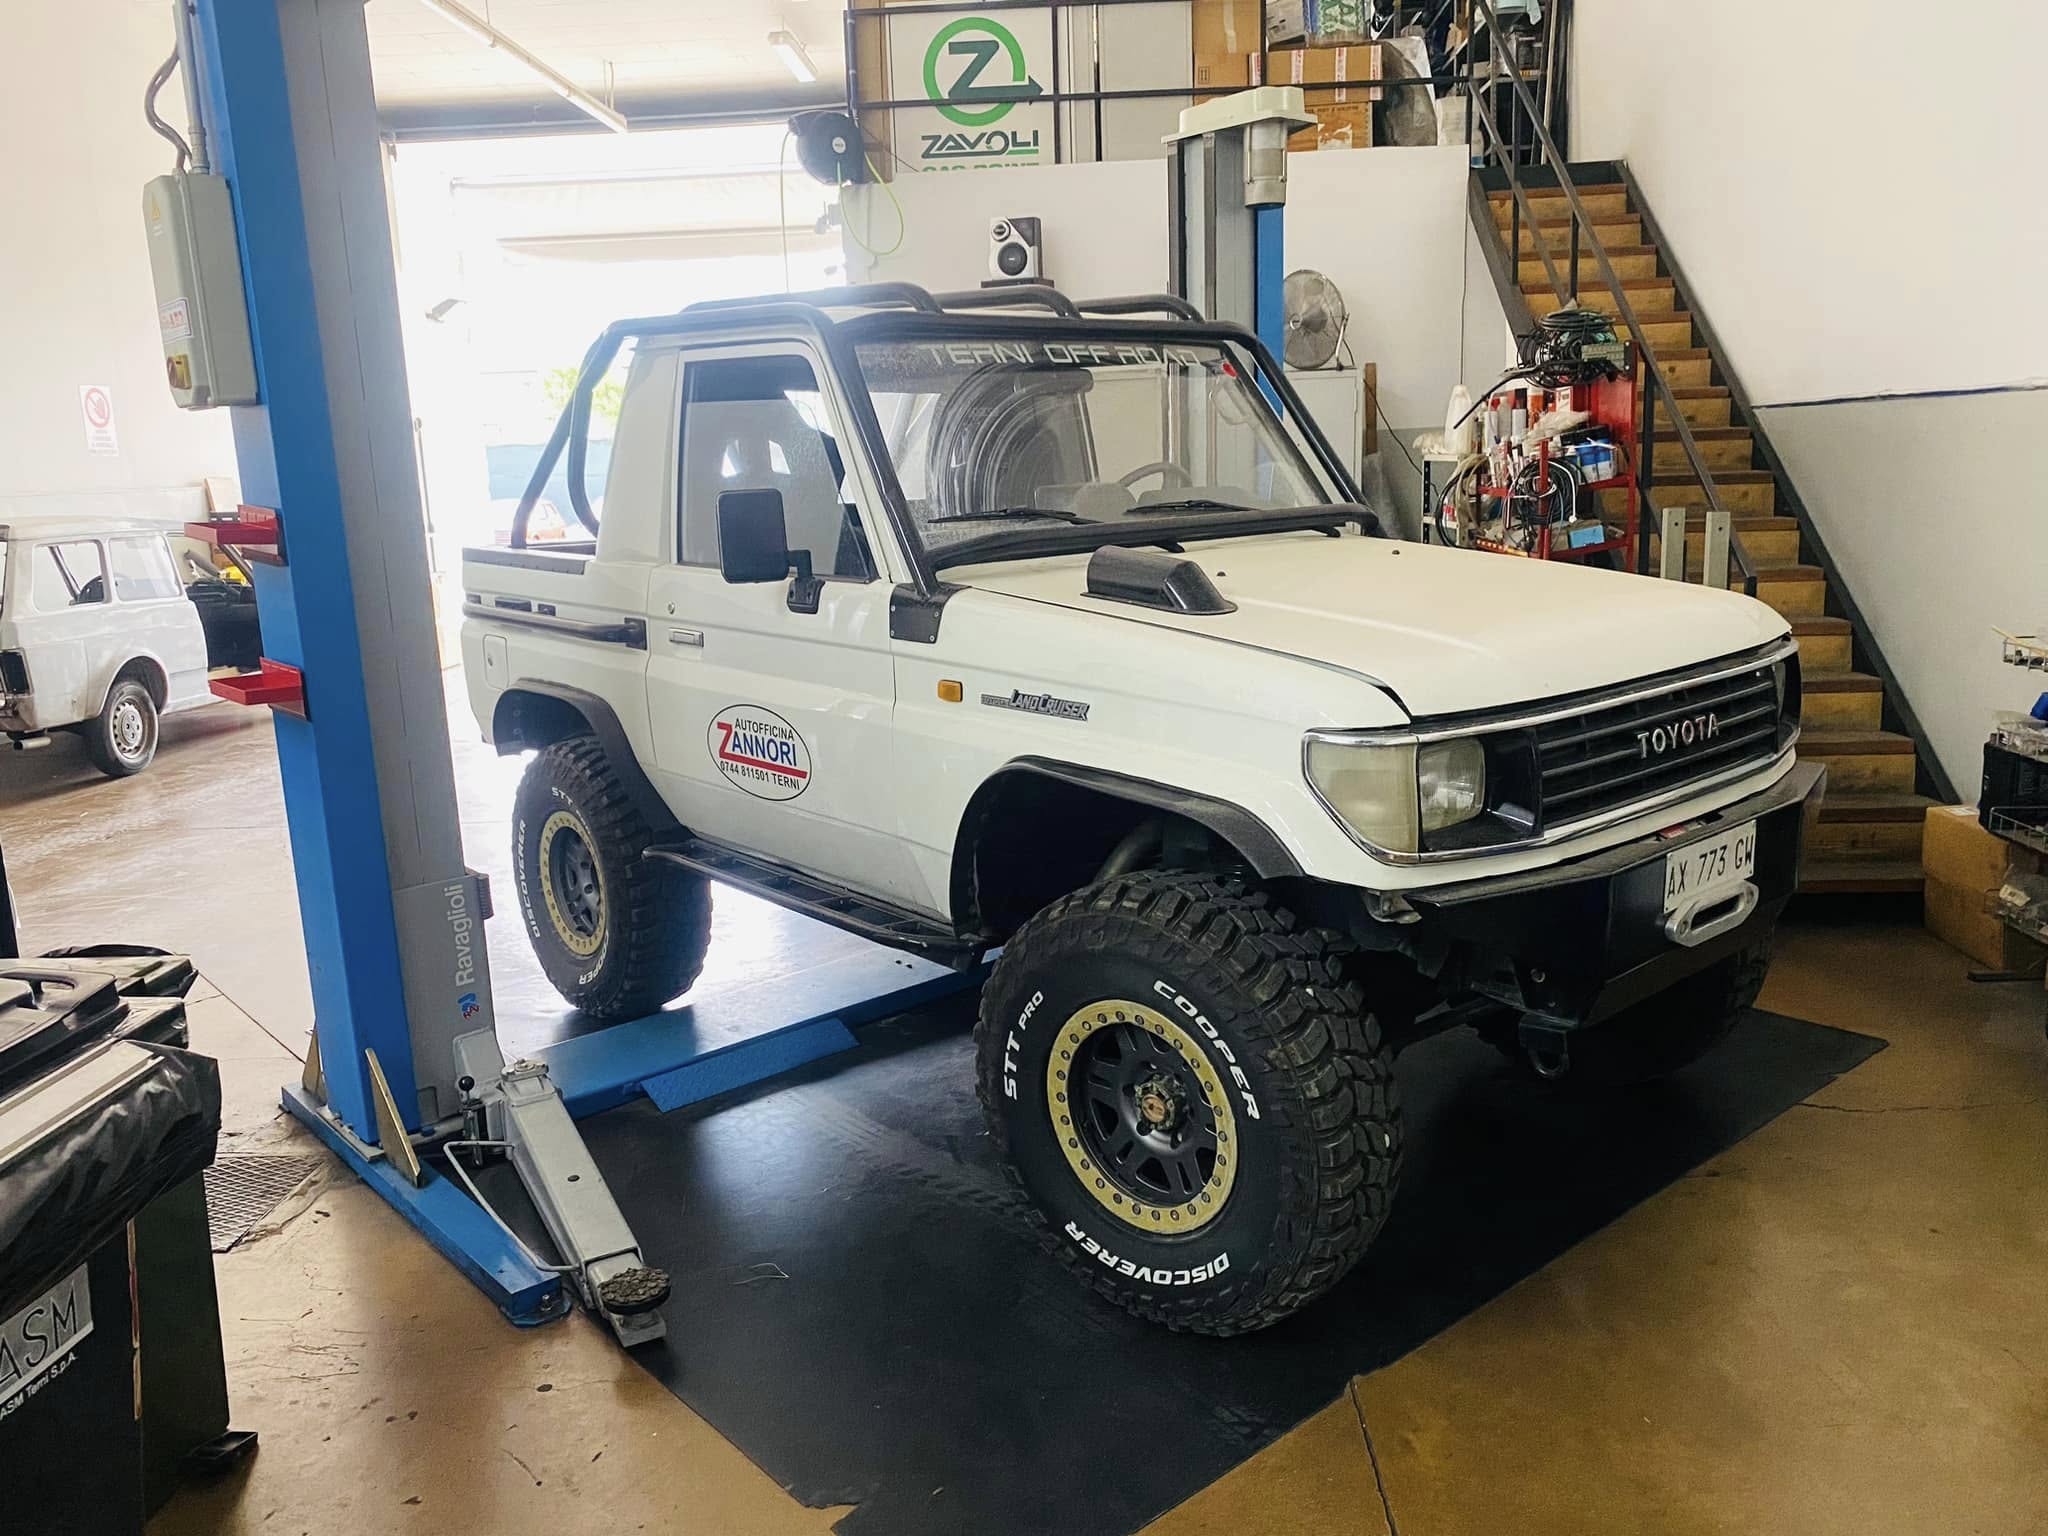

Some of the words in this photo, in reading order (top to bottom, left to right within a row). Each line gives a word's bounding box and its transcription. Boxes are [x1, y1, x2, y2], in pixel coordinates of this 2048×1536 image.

[920, 129, 1040, 159] ZAVOLI
[918, 343, 1034, 366] TERNI
[1043, 343, 1110, 364] OFF
[1114, 345, 1201, 367] ROAD
[716, 721, 808, 780] ZANNORI
[734, 717, 795, 742] AUTOFFICINA
[1637, 712, 1720, 760] TOYOTA
[551, 786, 575, 806] STT
[720, 760, 739, 774] 0744
[741, 765, 770, 782] 811501
[772, 773, 800, 791] TERNI
[518, 818, 541, 938] DISCOVERER
[1666, 860, 1688, 899] AX
[1697, 844, 1728, 887] 773
[1735, 834, 1754, 870] GW
[444, 883, 476, 987] Ravaglioli
[578, 929, 610, 985] COOPER
[1003, 1030, 1022, 1101] STT
[1018, 990, 1044, 1031] PRO
[1153, 979, 1261, 1120] COOPER
[1064, 1219, 1232, 1286] DISCOVERER
[0, 1392, 25, 1421] ASM
